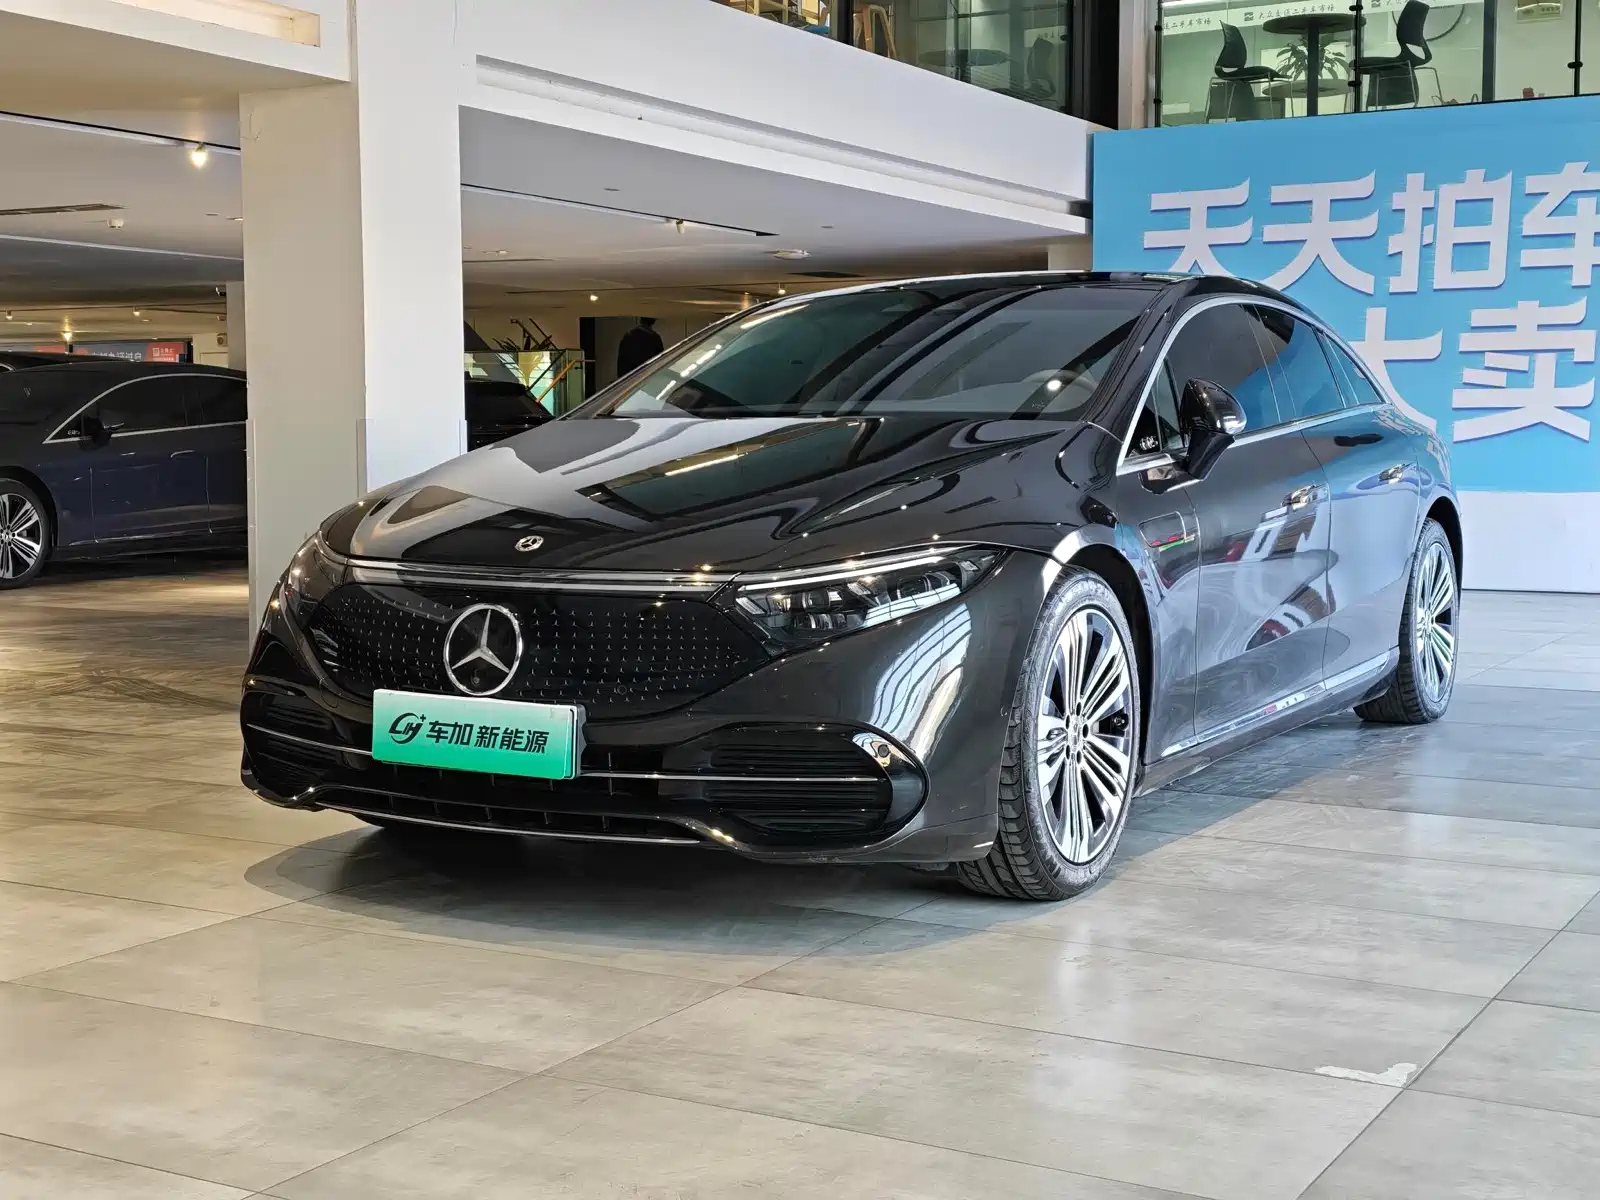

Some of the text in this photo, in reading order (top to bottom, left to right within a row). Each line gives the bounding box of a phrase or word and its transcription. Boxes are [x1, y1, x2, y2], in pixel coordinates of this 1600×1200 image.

[1144, 162, 1600, 295] 天天拍车
[426, 720, 549, 754] 车加新能源
